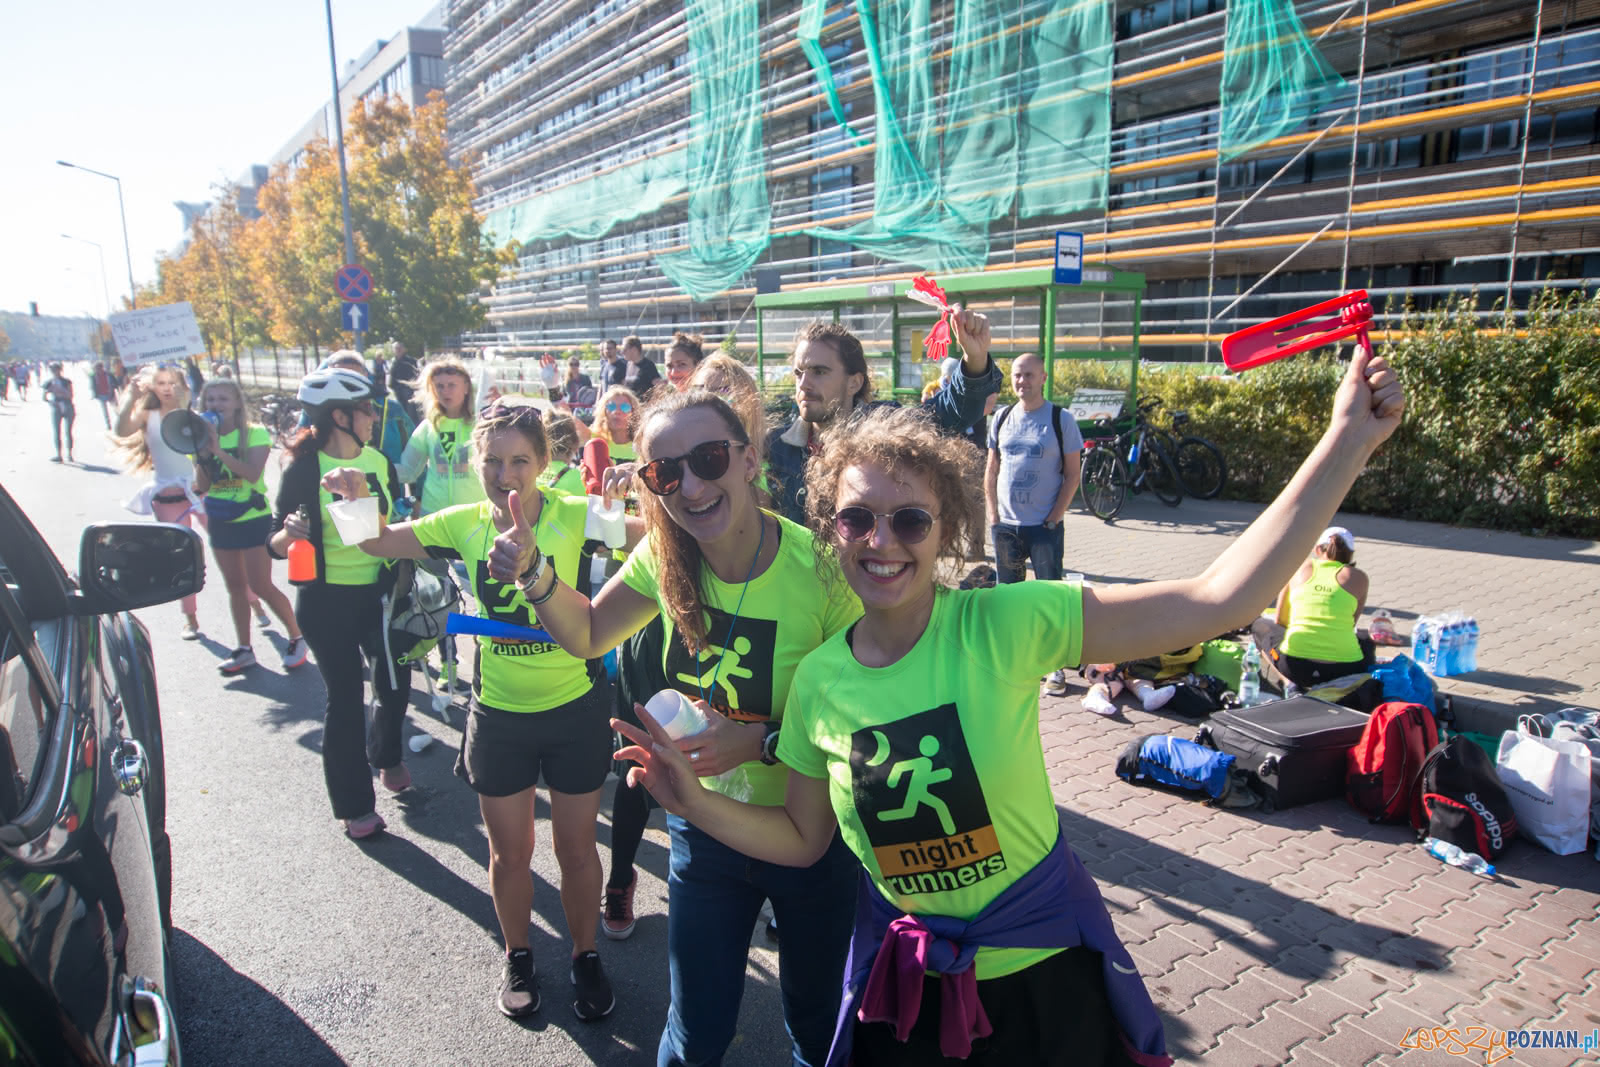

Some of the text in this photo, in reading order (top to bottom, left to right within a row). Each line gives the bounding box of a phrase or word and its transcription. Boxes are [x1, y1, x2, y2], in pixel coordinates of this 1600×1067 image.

[491, 641, 561, 656] runners
[1465, 792, 1503, 850] adidas
[900, 834, 978, 868] night
[886, 854, 1006, 895] runners
